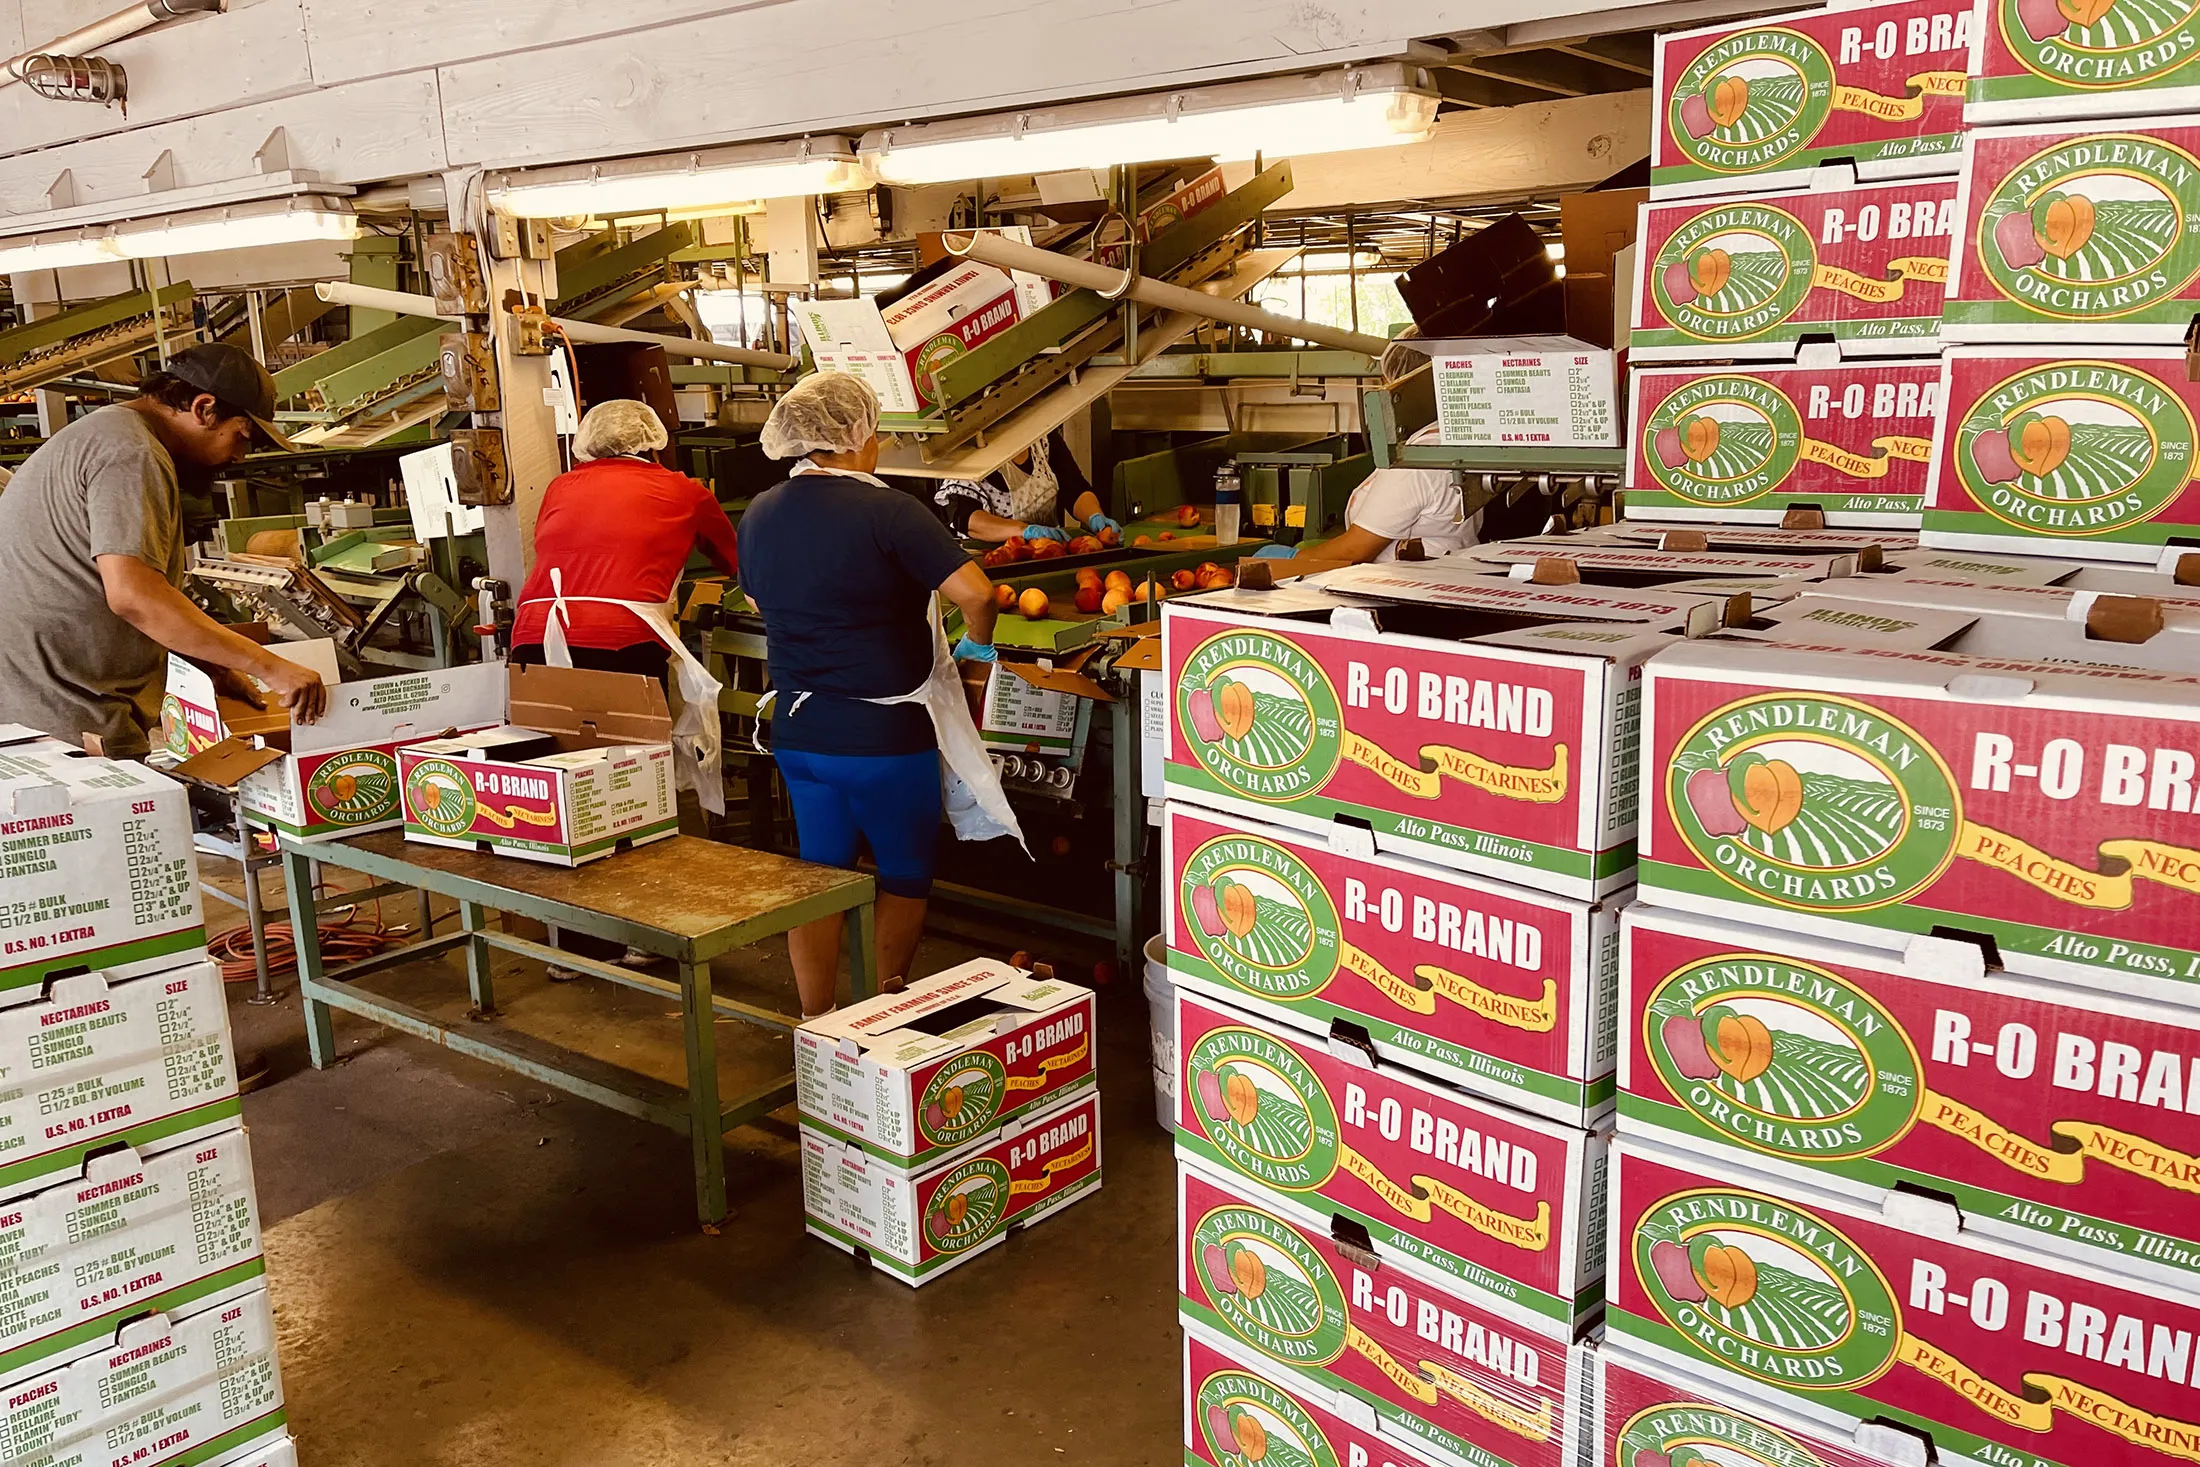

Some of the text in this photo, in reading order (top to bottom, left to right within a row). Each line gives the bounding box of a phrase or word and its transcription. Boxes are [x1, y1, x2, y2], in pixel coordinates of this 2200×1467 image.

[1693, 34, 1813, 80] RENDLEMAN
[1840, 21, 1897, 65] R-O
[2038, 29, 2195, 78] ORCHARDS
[1841, 93, 1905, 118] PEACHES
[1697, 128, 1800, 166] ORCHARDS
[2015, 145, 2192, 195] RENDLEMAN
[1181, 176, 1220, 212] R-O BRAND
[1676, 210, 1795, 250] RENDLEMAN
[1822, 205, 1880, 244] R-O
[926, 284, 956, 307] FARMING
[1823, 271, 1886, 298] PEACHES
[2015, 270, 2168, 309] ORCHARDS
[904, 301, 928, 317] SINCE
[962, 300, 1012, 342] R-O BRAND
[1678, 303, 1781, 333] ORCHARDS
[920, 337, 957, 366] RENDLEMAN
[1445, 360, 1472, 369] PEACHES
[1503, 359, 1541, 367] NECTARINES
[1574, 357, 1588, 365] SIZE
[1504, 386, 1531, 394] FANTASIA
[1529, 369, 1551, 377] BEAUTS
[1666, 381, 1782, 417] RENDLEMAN
[1807, 384, 1865, 419] R-O
[1992, 370, 2168, 416] RENDLEMAN
[1473, 433, 1492, 441] PEACH
[2160, 441, 2188, 450] SINCE
[1810, 445, 1872, 474] PEACHES
[2163, 452, 2184, 460] 1873
[1670, 472, 1769, 498] ORCHARDS
[1843, 498, 1911, 510] Alto Pass,
[1992, 489, 2143, 527] ORCHARDS
[1499, 549, 1827, 571] FAMILY FARMING SINCE 1873
[1424, 583, 1678, 615] FARMING SINCE 1873
[1196, 634, 1319, 691] RENDLEMAN
[1346, 661, 1554, 738] R-O BRAND
[1316, 718, 1338, 729] SINCE
[1319, 728, 1335, 738] 1873
[1703, 703, 1922, 771] RENDLEMAN
[319, 753, 390, 778] RENDLEMAN
[413, 763, 465, 786] RENDLEMAN
[1205, 747, 1311, 793] ORCHARDS
[1351, 742, 1552, 794] PEACHES NECTARINES
[1971, 731, 2084, 799] R-O
[475, 772, 549, 800] R-O BRAND
[1, 813, 74, 835] NECTARINES
[131, 800, 155, 814] SIZE
[330, 800, 391, 821] ORCHARDS
[422, 813, 466, 833] ORCHARDS
[480, 806, 551, 826] PEACHES NECTARINES
[2, 828, 92, 852] SUMMER BEAUTS
[5, 849, 47, 864] SUNGLO
[1393, 818, 1534, 862] Alto Pass, Illinois
[6, 860, 57, 878] FANTASIA
[1200, 844, 1318, 901] RENDLEMAN
[1715, 844, 1897, 900] ORCHARDS
[1976, 837, 2096, 902] PEACHES
[12, 902, 26, 914] 25
[39, 895, 66, 908] BULK
[5, 926, 95, 954] U.S. NO. 1 EXTRA
[1344, 877, 1542, 972] R-O BRAND
[1209, 941, 1311, 989] ORCHARDS
[2042, 934, 2175, 977] Alto Pass,
[849, 1010, 890, 1030] FAMILY
[889, 991, 940, 1015] FARMING
[935, 980, 969, 997] SINCE
[968, 971, 996, 985] 1873
[1349, 952, 1542, 1023] PEACHES NECTARINES
[1679, 965, 1885, 1038] RENDLEMAN
[40, 1000, 110, 1027] NECTARINES
[1005, 1012, 1083, 1065] R-O BRAND
[1931, 1008, 2036, 1079] R-O
[930, 1052, 993, 1093] RENDLEMAN
[1010, 1047, 1085, 1088] PEACHES NECTARINES
[1207, 1038, 1318, 1100] RENDLEMAN
[937, 1108, 992, 1143] ORCHARDS
[1689, 1087, 1864, 1149] ORCHARDS
[1010, 1113, 1088, 1169] R-O BRAND
[1214, 1128, 1311, 1182] ORCHARDS
[1343, 1082, 1538, 1193] R-O BRAND
[1935, 1104, 2051, 1173] PEACHES
[77, 1173, 143, 1203] NECTARINES
[935, 1158, 998, 1203] RENDLEMAN
[1014, 1148, 1090, 1192] PEACHES NECTARINES
[78, 1184, 160, 1218] SUMMER BEAUTS
[1348, 1155, 1536, 1243] PEACHES NECTARINES
[941, 1212, 997, 1249] ORCHARDS
[1214, 1213, 1326, 1281] RENDLEMAN
[1669, 1198, 1863, 1278] RENDLEMAN
[1352, 1268, 1540, 1388] R-O BRAND
[1909, 1258, 2200, 1388] R-O BRAN
[109, 1336, 171, 1369] NECTARINES
[1678, 1309, 1843, 1377] ORCHARDS
[1356, 1335, 1420, 1395] PEACHES
[1914, 1347, 2021, 1420] PEACHES
[9, 1382, 58, 1408] PEACHES
[10, 1396, 61, 1423] REDHAVEN
[113, 1380, 157, 1405] FANTASIA
[11, 1410, 56, 1434] BELLAIRE
[15, 1432, 55, 1455] BOUNTY
